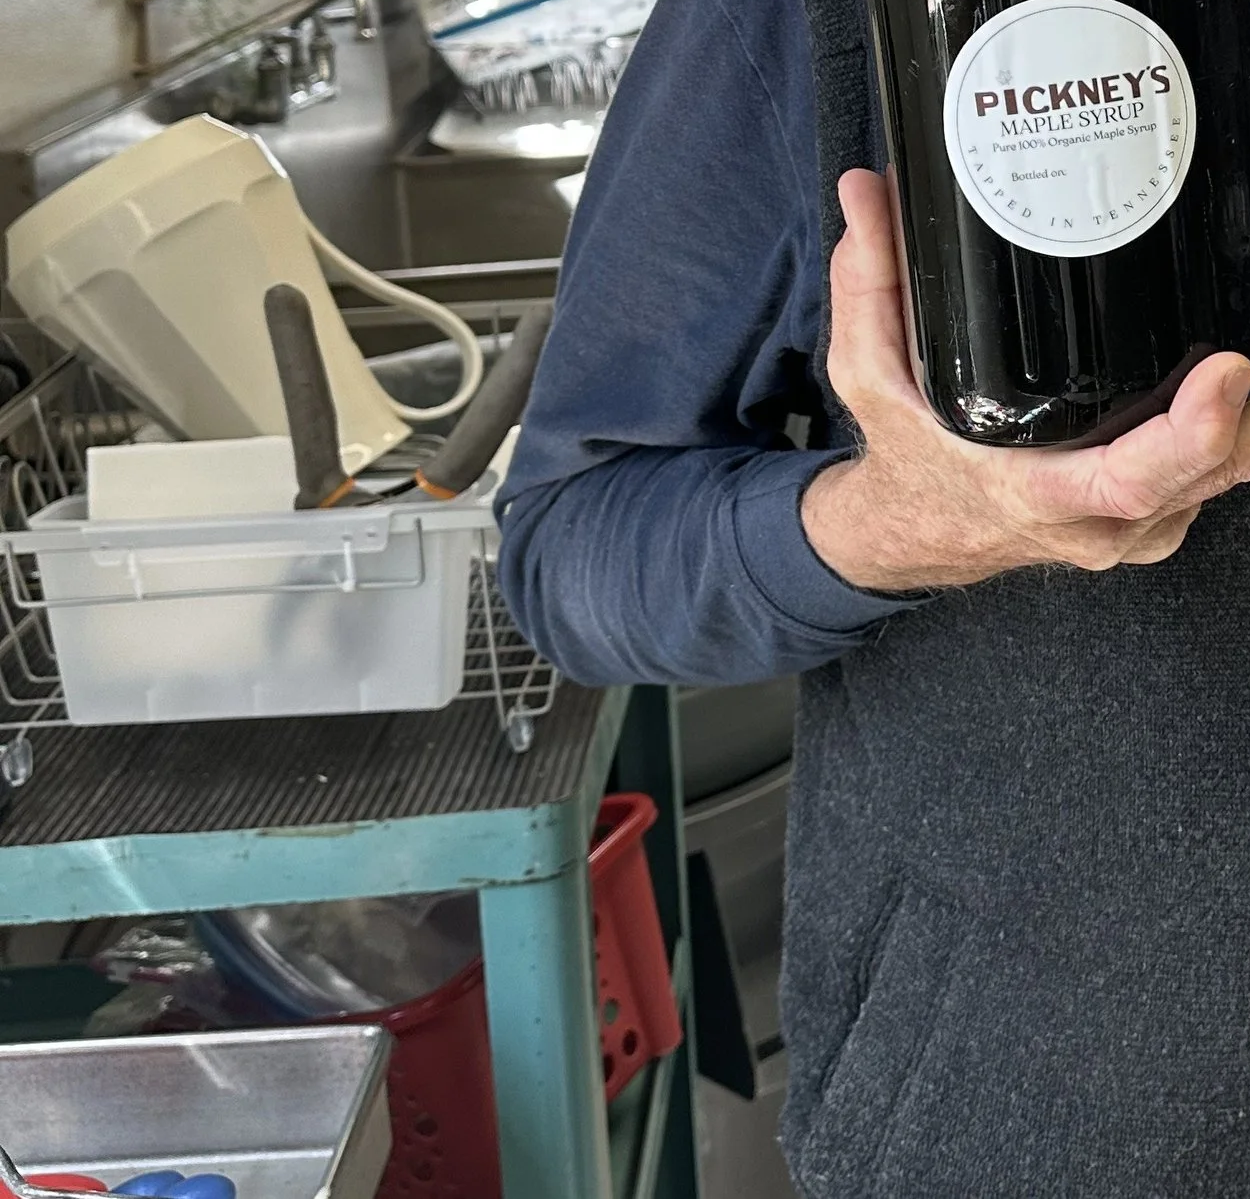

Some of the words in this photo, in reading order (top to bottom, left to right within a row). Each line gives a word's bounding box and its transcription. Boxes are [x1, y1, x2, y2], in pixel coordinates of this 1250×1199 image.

[974, 65, 1171, 117] PICKNEY'S
[1000, 114, 1074, 137] MAPLE
[1079, 101, 1145, 128] SYRUP
[993, 141, 1017, 153] Pure
[1018, 138, 1047, 151] 100%
[1048, 134, 1091, 148] Organic
[1093, 128, 1125, 143] Maple
[1127, 122, 1157, 135] Syrup
[968, 145, 1031, 218] TAPPED
[1050, 217, 1073, 228] IN
[1093, 117, 1181, 225] TENNESSEE
[1011, 170, 1048, 182] Bottled
